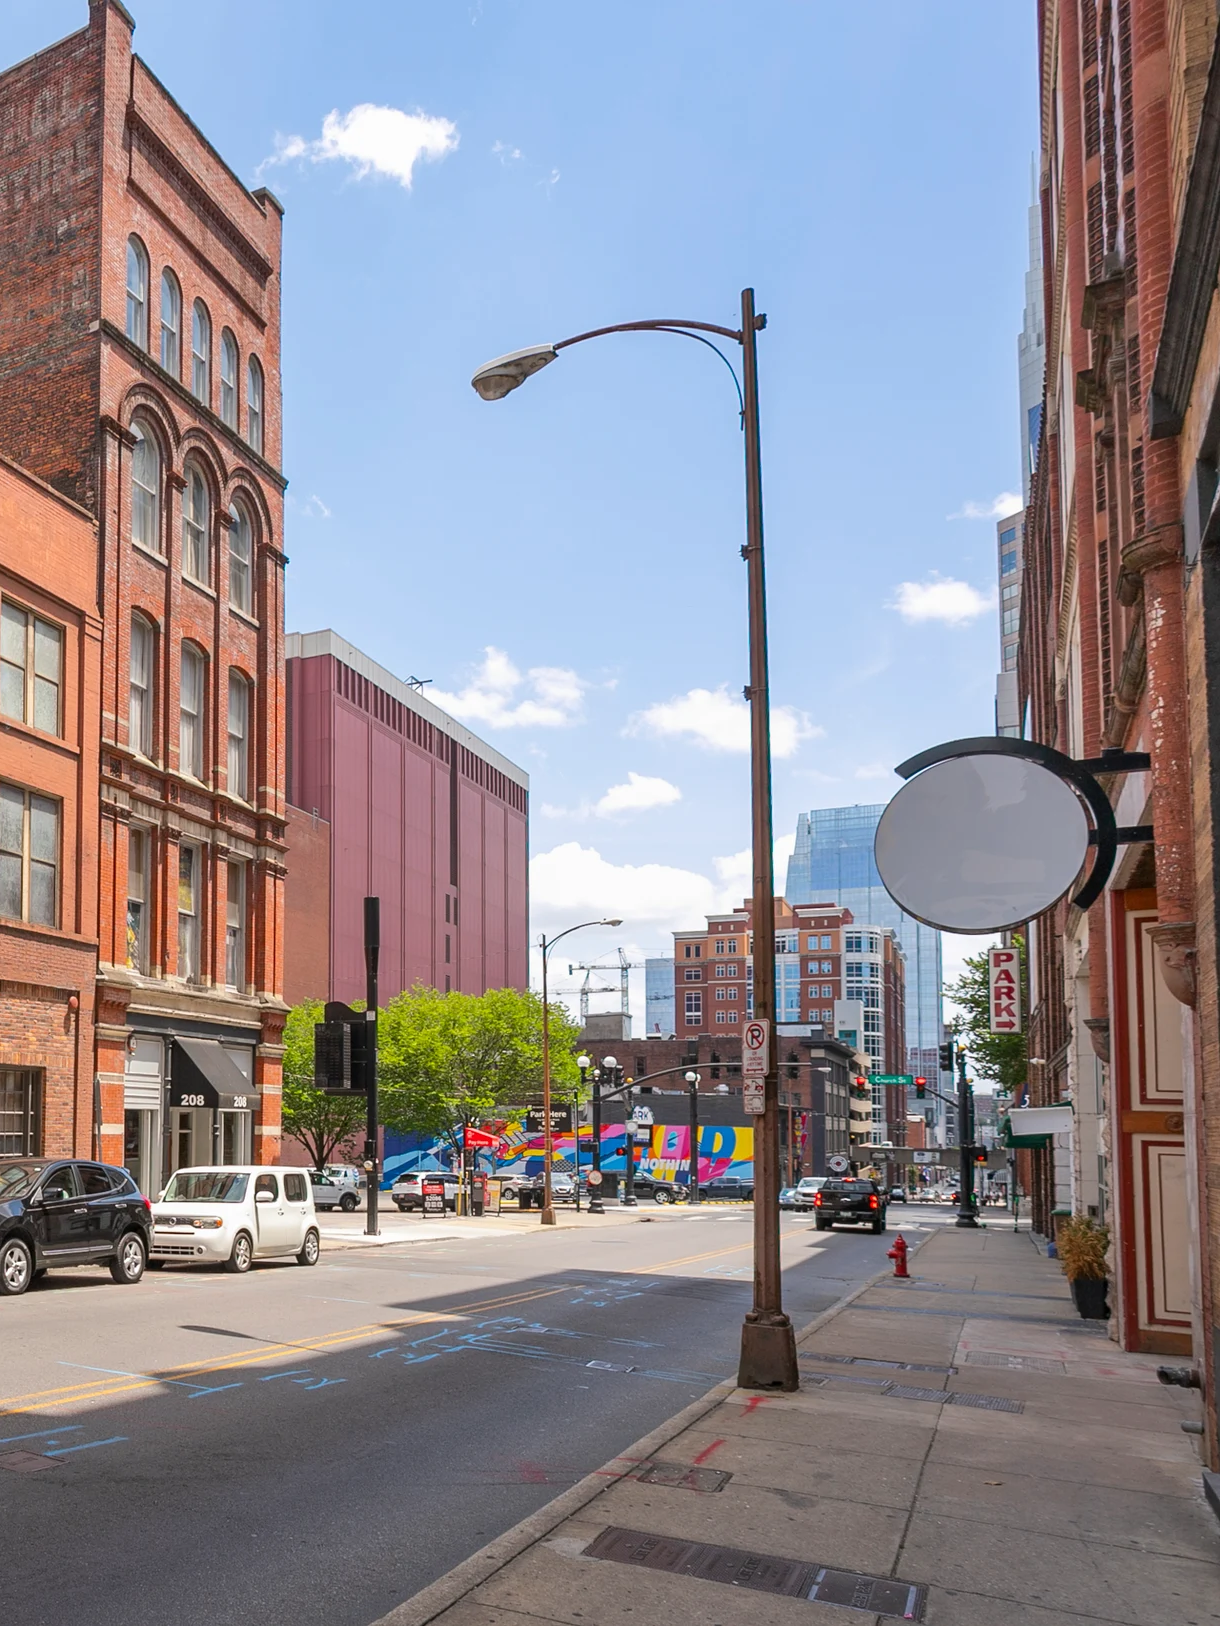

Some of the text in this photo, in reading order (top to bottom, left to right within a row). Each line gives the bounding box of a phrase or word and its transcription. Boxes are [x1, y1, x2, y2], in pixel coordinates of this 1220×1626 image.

[992, 952, 1016, 1018] PARK
[875, 1076, 907, 1084] Church St
[180, 1094, 205, 1106] 208
[233, 1096, 247, 1107] 208
[633, 1110, 648, 1120] ARK
[640, 1158, 691, 1171] NOTHIN
